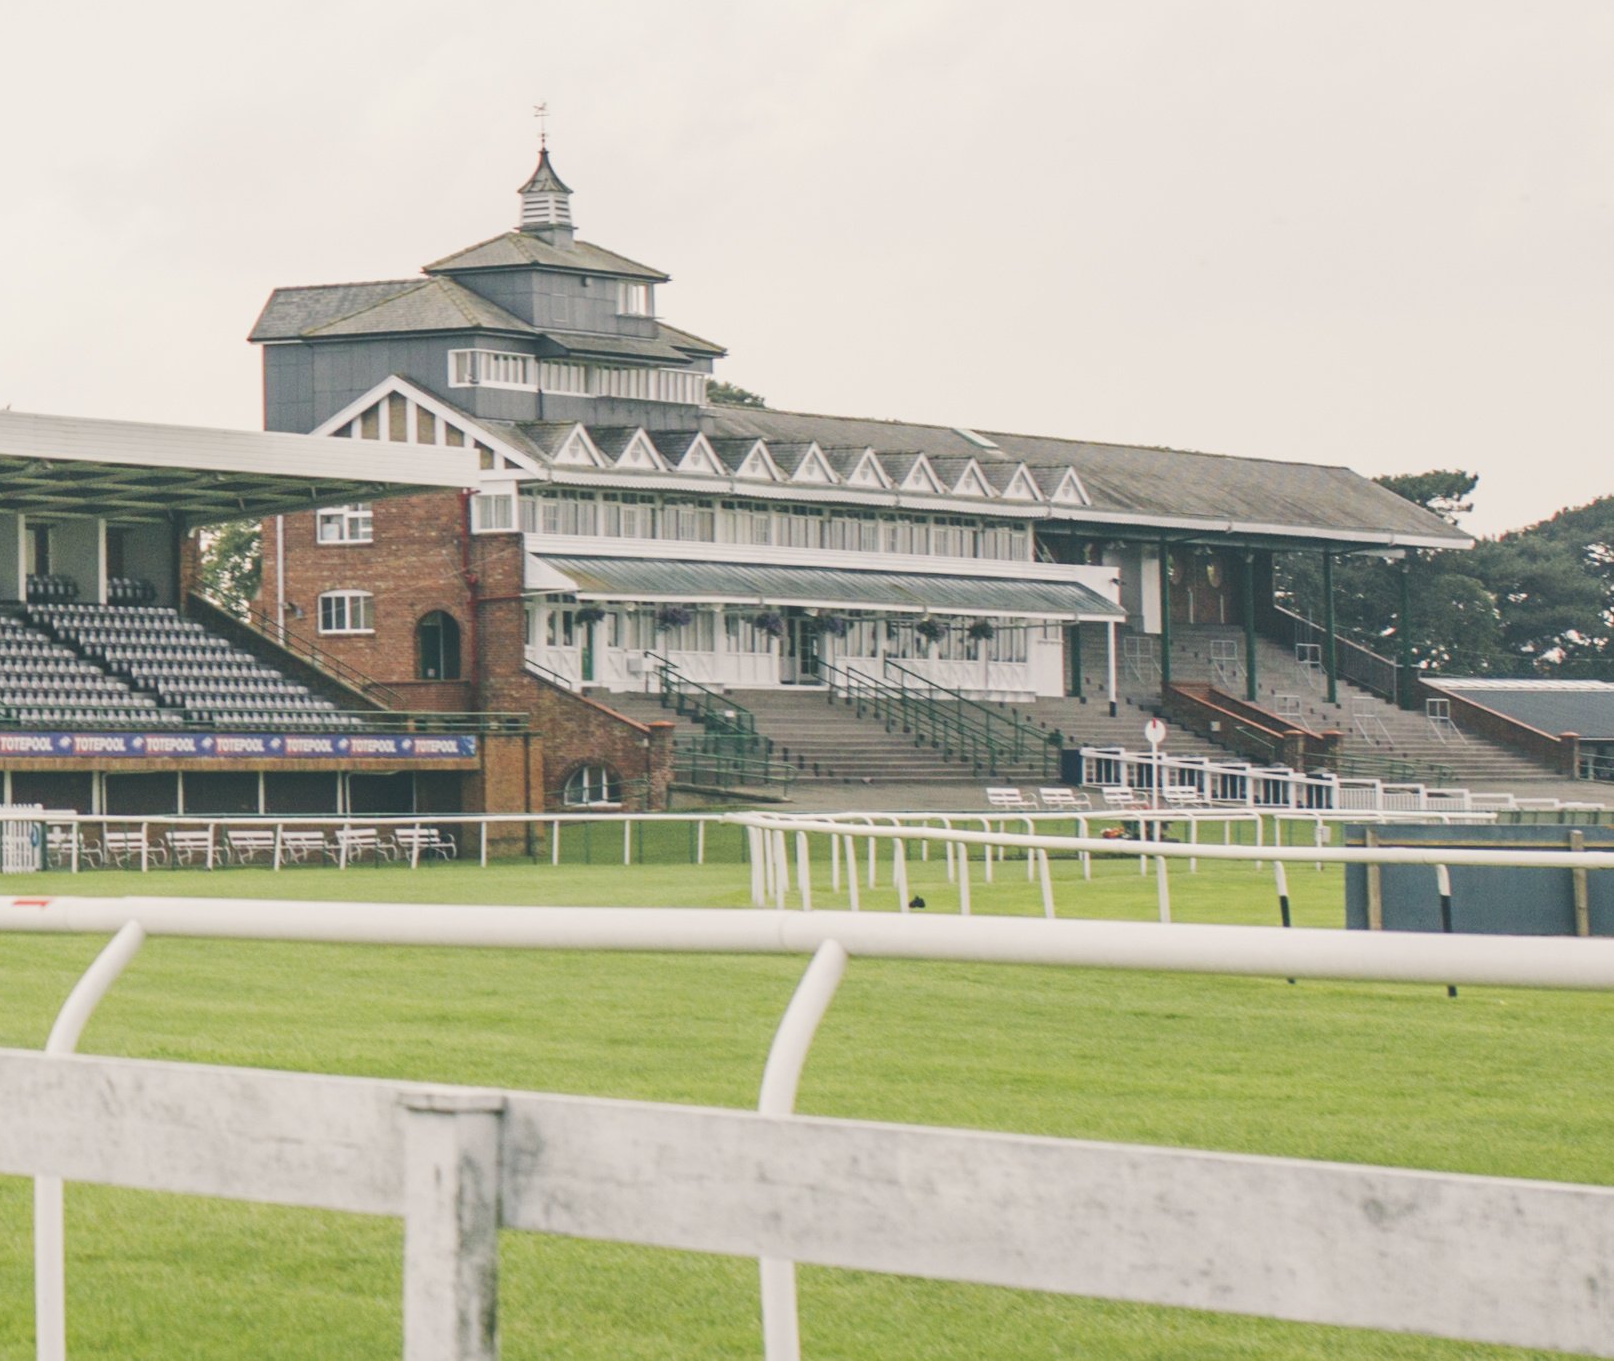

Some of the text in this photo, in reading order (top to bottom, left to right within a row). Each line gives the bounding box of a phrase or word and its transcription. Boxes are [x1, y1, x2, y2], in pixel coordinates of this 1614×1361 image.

[0, 736, 459, 753] TOTEPOOL TOTEPOOL TOTEPOOL TOTEPOOL TOTEPOOL TOTEPOOL TOTEPOOL
